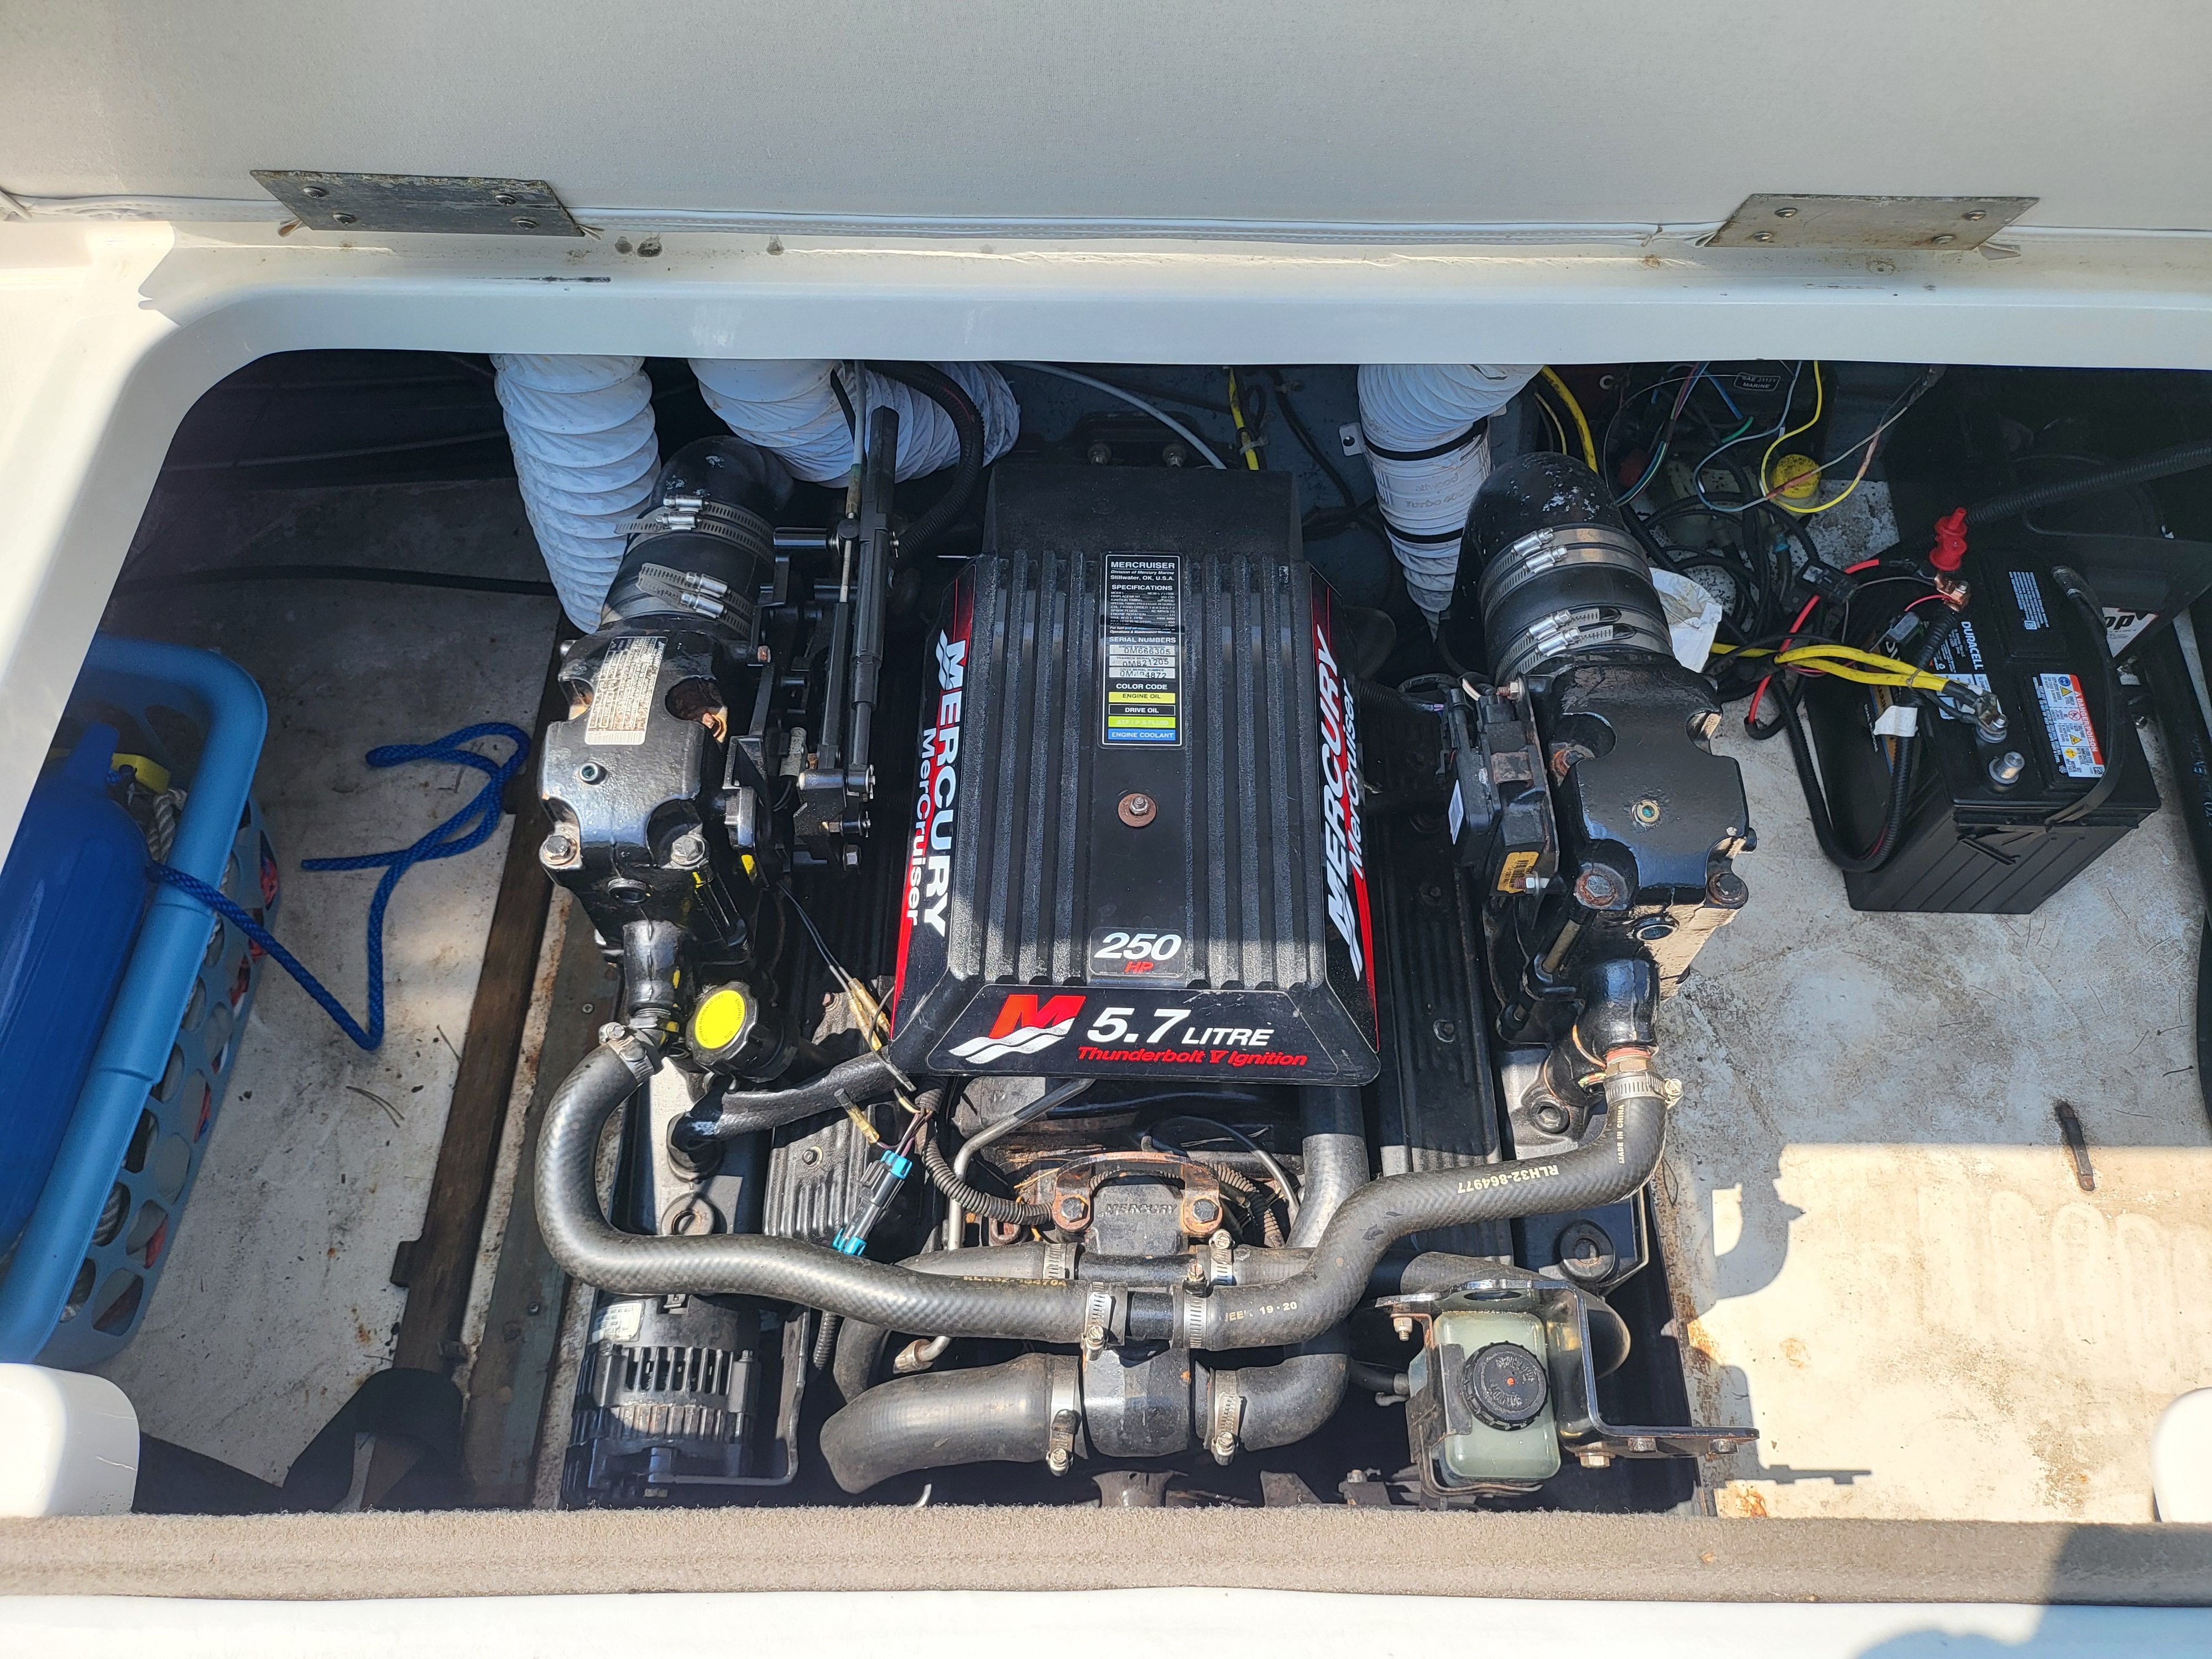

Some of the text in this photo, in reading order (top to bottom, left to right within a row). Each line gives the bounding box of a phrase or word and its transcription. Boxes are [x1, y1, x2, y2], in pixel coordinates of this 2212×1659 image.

[653, 642, 664, 667] MERCURY
[1961, 622, 1984, 670] DURACELL
[2076, 698, 2097, 753] DANGER/POISON
[924, 632, 966, 937] MERCURY
[1343, 677, 1363, 881] MerCruiser
[1316, 624, 1359, 965] MERCURY
[907, 728, 938, 926] MerCruiser
[1094, 932, 1184, 961] 250
[1124, 961, 1154, 973] HP
[724, 1031, 733, 1040] OIL
[1087, 1008, 1275, 1046] 5.7 LITRE
[1078, 1046, 1207, 1064] Thunderbolt
[1227, 1052, 1308, 1067] Ignition
[1616, 1104, 1625, 1128] CHINA
[1616, 1131, 1624, 1139] IN
[1457, 1165, 1559, 1196] RLH32-864977
[1105, 1203, 1178, 1215] MERCURY
